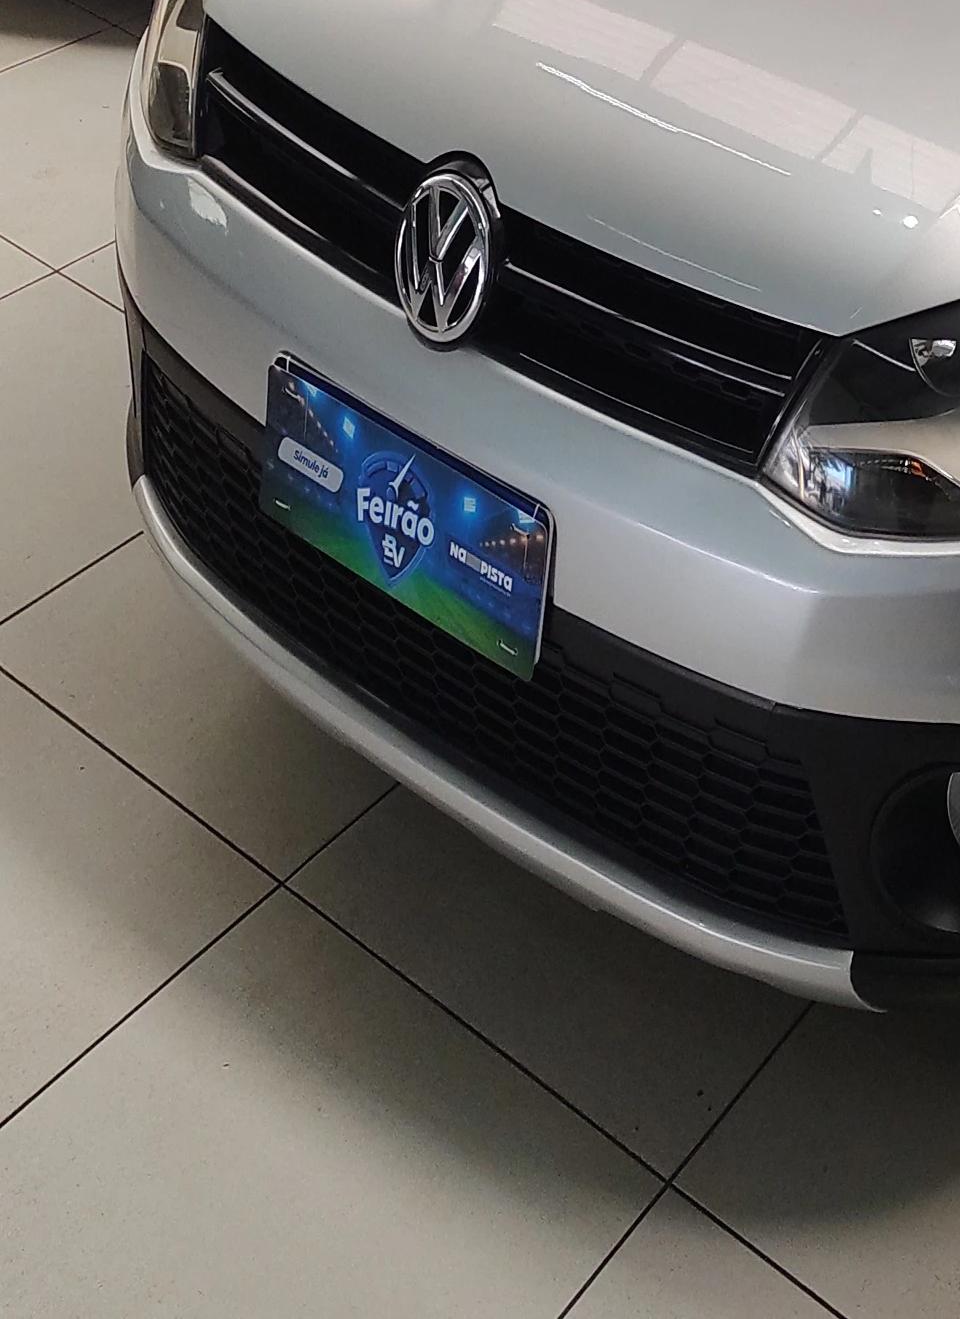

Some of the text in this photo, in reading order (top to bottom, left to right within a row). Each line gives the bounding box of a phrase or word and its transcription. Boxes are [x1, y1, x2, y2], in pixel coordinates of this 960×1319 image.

[293, 449, 329, 479] Simule já
[356, 487, 435, 547] Feirão
